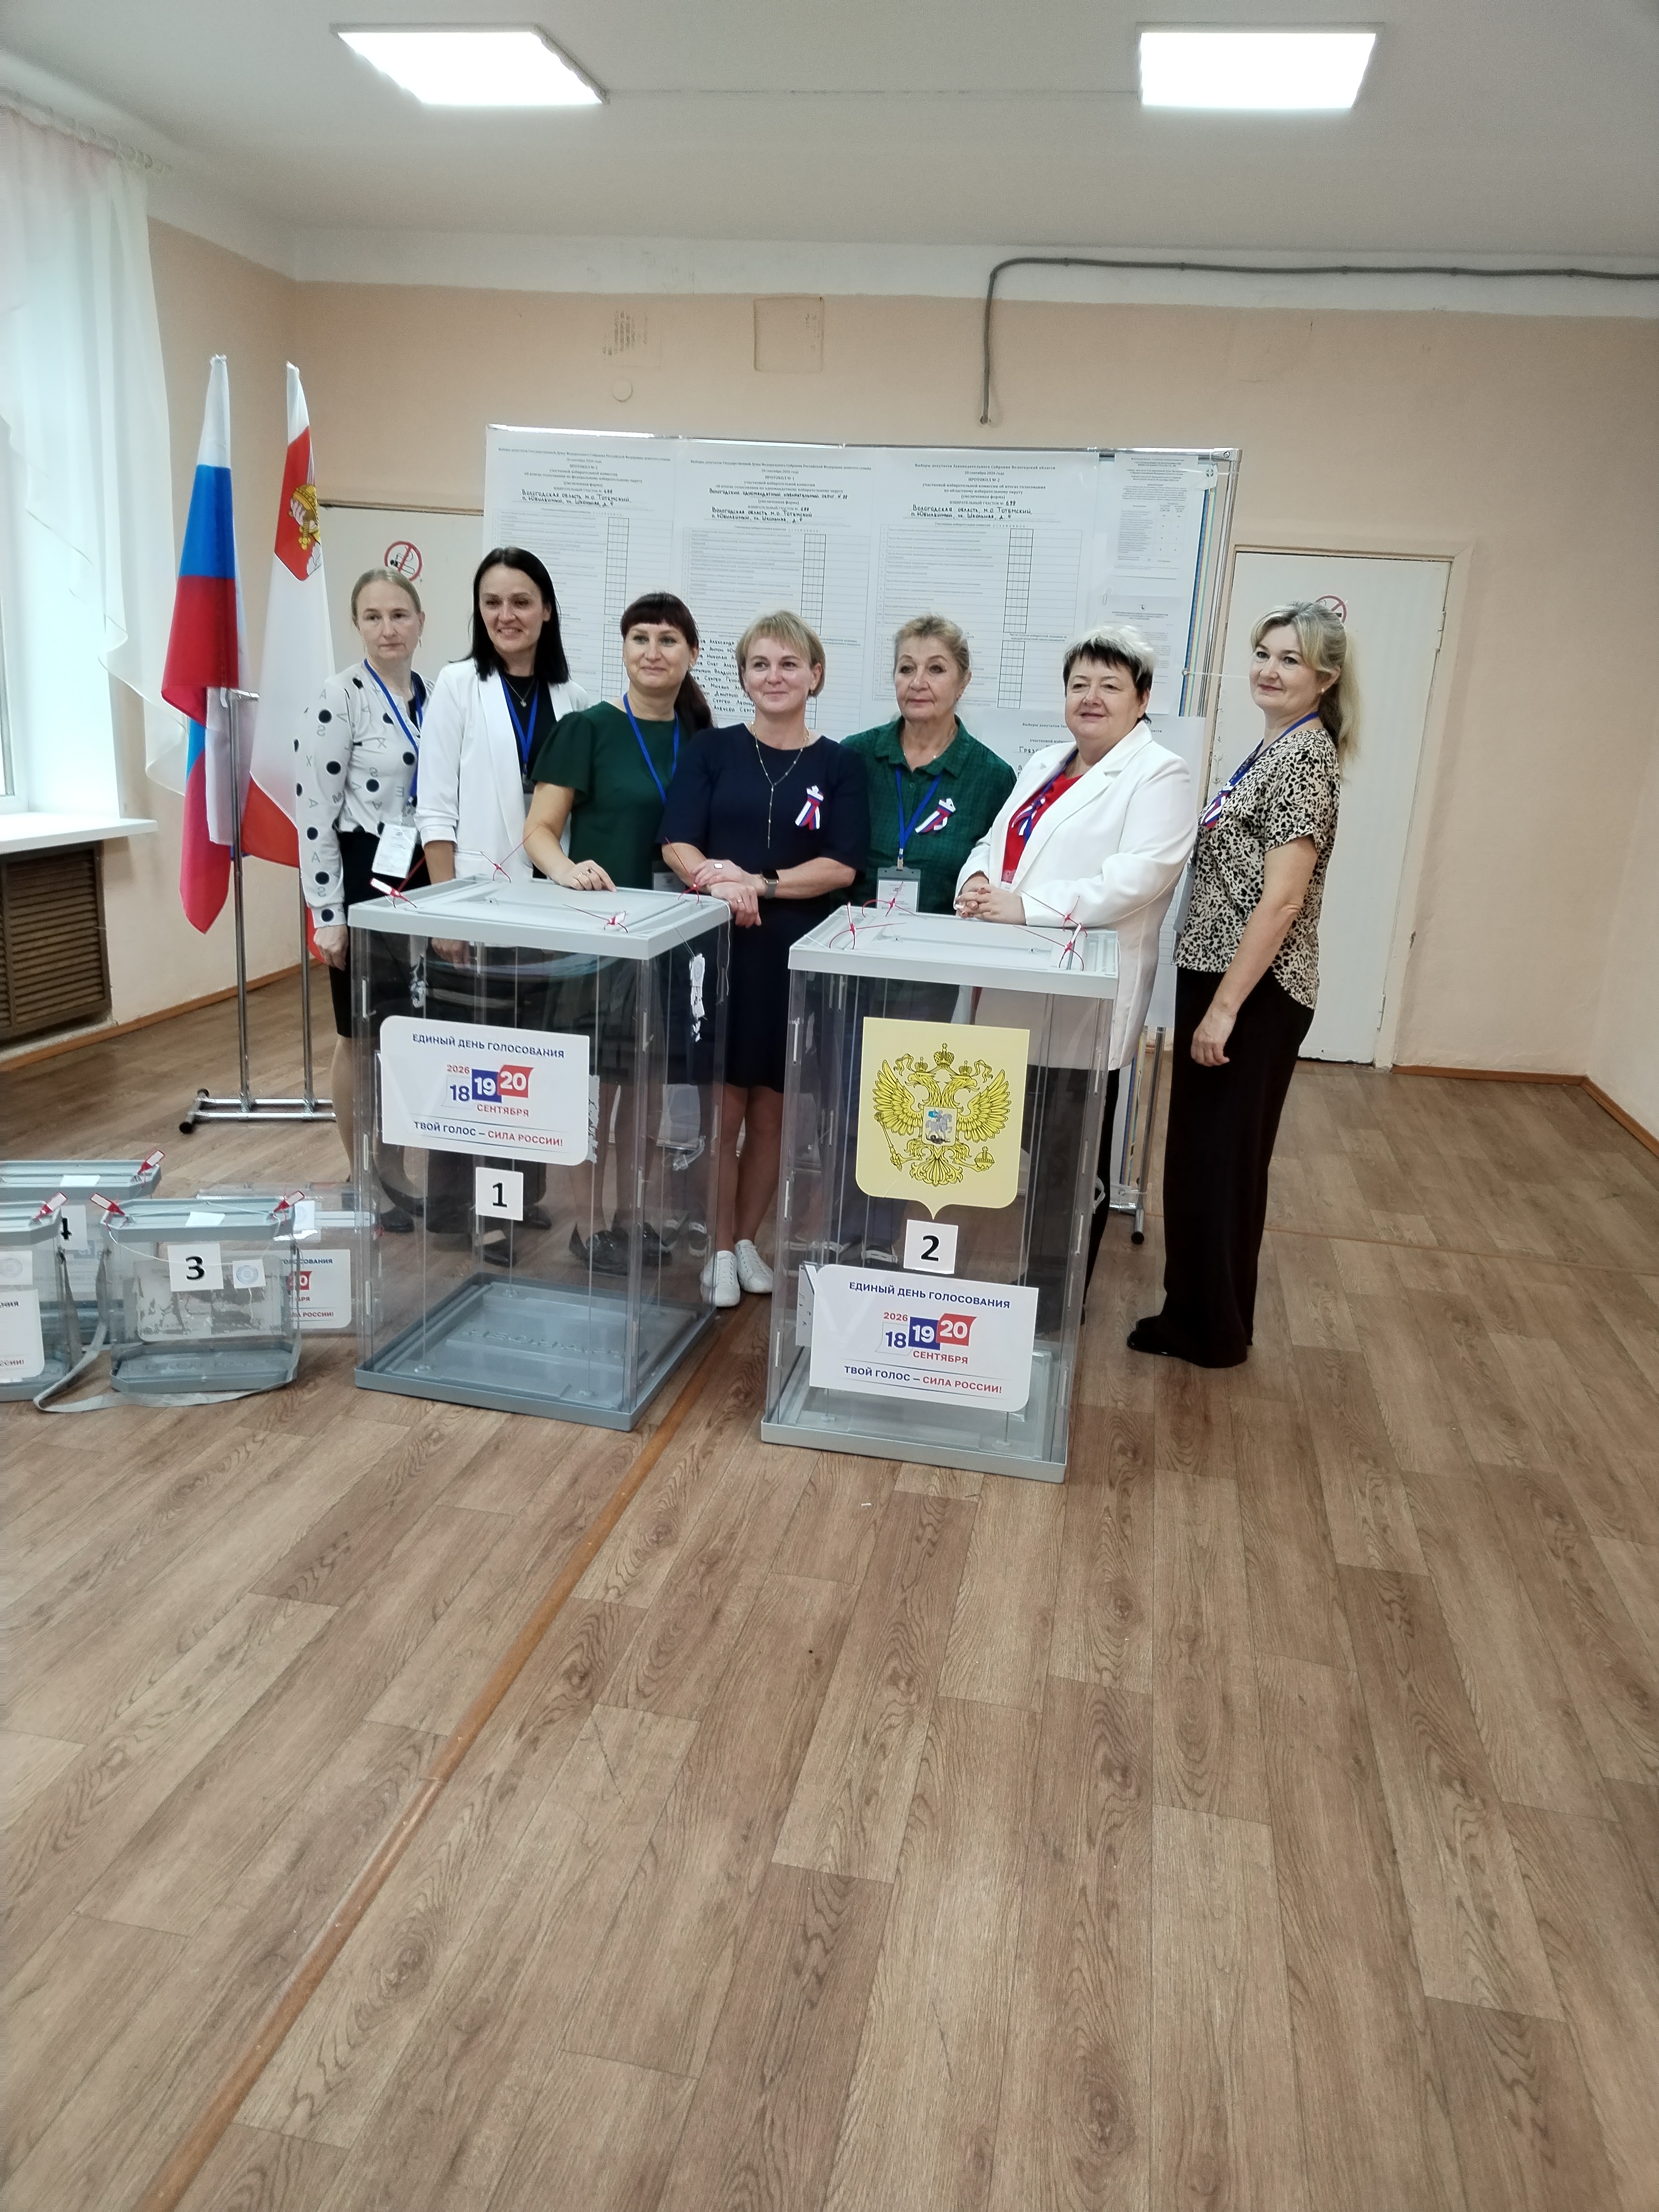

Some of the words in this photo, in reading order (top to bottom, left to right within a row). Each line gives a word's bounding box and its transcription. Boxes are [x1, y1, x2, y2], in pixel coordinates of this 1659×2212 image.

[412, 1033, 456, 1046] ЕДИНЫЙ
[457, 1038, 485, 1050] ДЕНЬ
[487, 1042, 565, 1058] ГОЛОСОВАНИЯ
[446, 1064, 470, 1074] 2026
[449, 1084, 470, 1102] 18
[474, 1077, 496, 1096] 19
[499, 1071, 527, 1091] 20
[477, 1104, 529, 1117] СЕНТЯБРЯ
[414, 1120, 441, 1132] ТВОЙ
[443, 1125, 476, 1137] ГОЛОС
[488, 1130, 516, 1142] СИЛА
[518, 1133, 563, 1147] РОССИИ!
[492, 1182, 507, 1208] 1
[920, 1235, 940, 1262] 2
[185, 1255, 205, 1281] 3
[849, 1281, 895, 1296] ЕДИНЫЙ
[897, 1287, 926, 1299] ДЕНЬ
[929, 1291, 1010, 1309] ГОЛОСОВАНИЯ
[883, 1311, 908, 1322] 2026
[886, 1331, 907, 1349] 18
[913, 1324, 935, 1343] 19
[939, 1320, 968, 1339] 20
[913, 1350, 969, 1365] СЕНТЯБРЯ
[844, 1365, 873, 1377] ТВОЙ
[875, 1370, 911, 1382] ГОЛОС
[923, 1376, 953, 1388] СИЛА
[955, 1380, 1003, 1394] РОССИИ!
